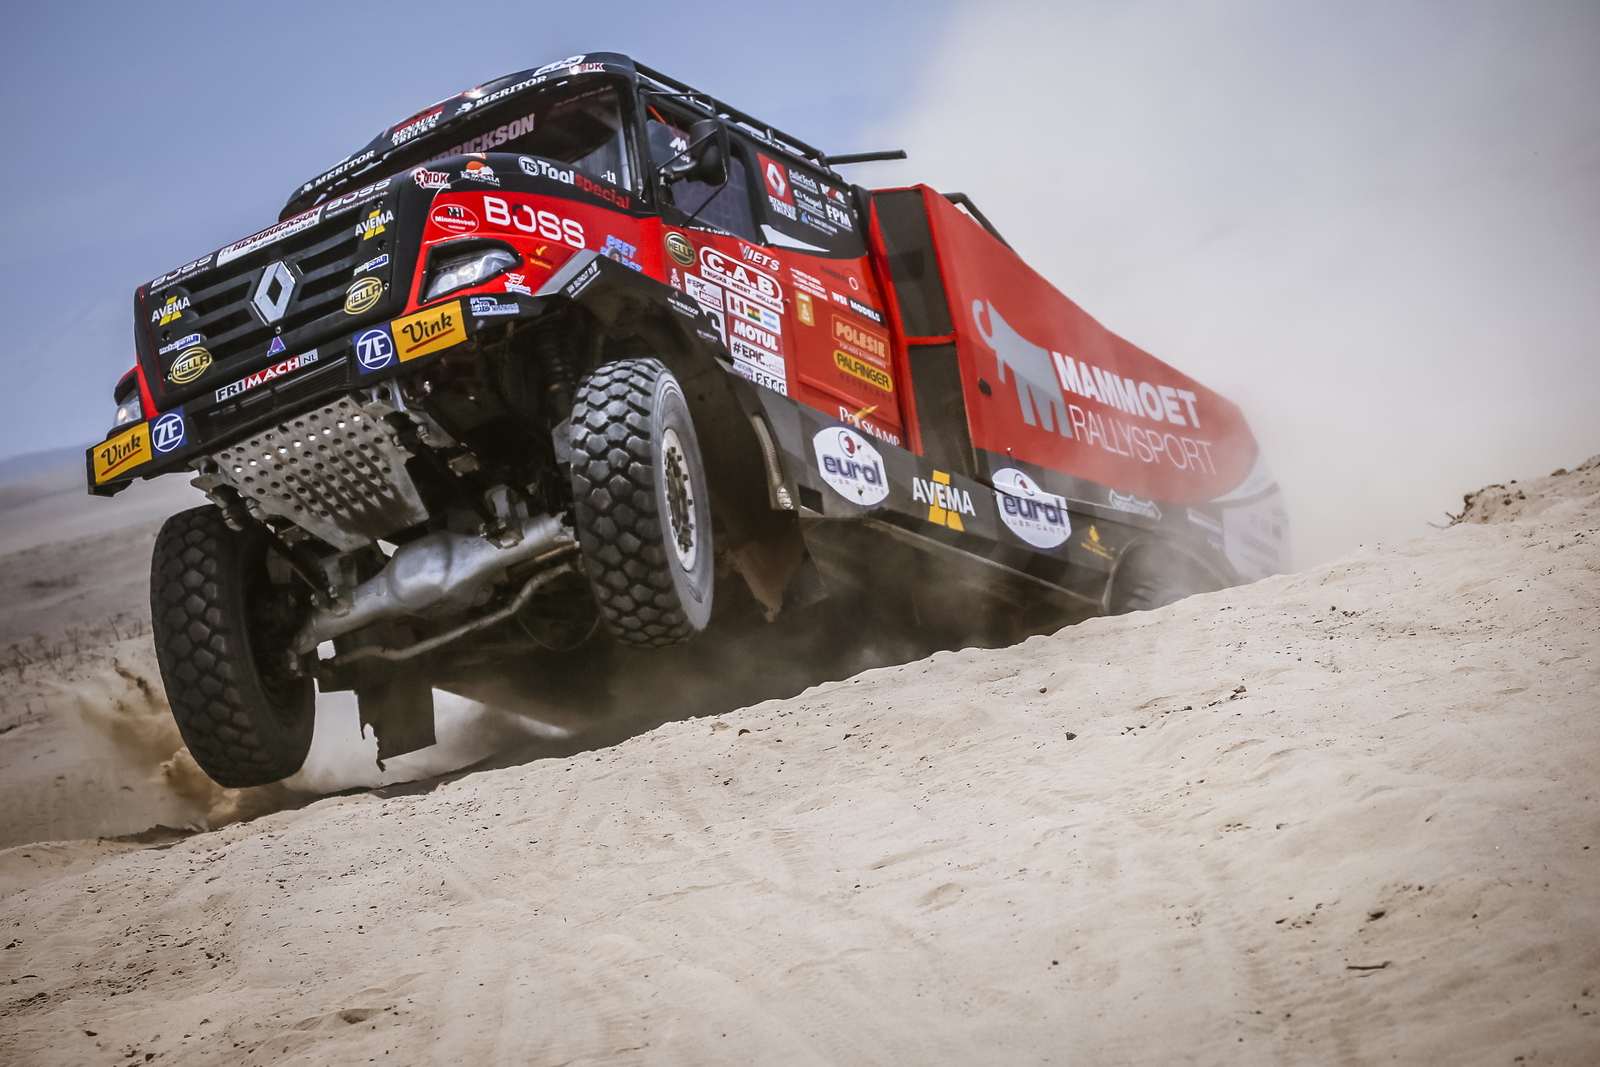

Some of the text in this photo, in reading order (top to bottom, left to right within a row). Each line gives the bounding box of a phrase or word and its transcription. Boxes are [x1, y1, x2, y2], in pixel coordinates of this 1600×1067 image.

[475, 75, 547, 108] MERITOR
[391, 111, 443, 141] RENAULT
[392, 120, 437, 146] TRUCKS
[315, 150, 375, 187] MERITOR
[521, 160, 536, 172] TS
[326, 178, 392, 211] BOSS
[232, 208, 320, 252] HENDRICKSON
[355, 210, 394, 236] AVEMA
[484, 196, 586, 248] BOSS
[826, 203, 853, 228] FPM
[605, 234, 637, 258] PEET
[668, 240, 695, 259] HELLA
[738, 242, 780, 271] VIETS
[150, 254, 214, 289] BOSS
[347, 283, 382, 305] HELLA
[151, 296, 191, 323] AVEMA
[849, 299, 881, 322] MODELS
[402, 312, 452, 343] Vink
[733, 319, 779, 351] MOTUL
[836, 321, 885, 358] POLESIE
[174, 350, 210, 376] HELLA
[358, 337, 392, 364] ZF
[837, 353, 890, 389] PALFINGER
[1052, 351, 1201, 429] MAMMOET
[101, 434, 142, 466] Vink
[154, 420, 183, 450] ZF
[1068, 404, 1216, 476] RALLYSPORT
[823, 454, 883, 487] eurol
[826, 476, 885, 495] LUBRICANTS
[912, 476, 976, 517] AVEMA
[1002, 492, 1065, 528] eurol
[1005, 517, 1068, 537] LUBRICANTS
